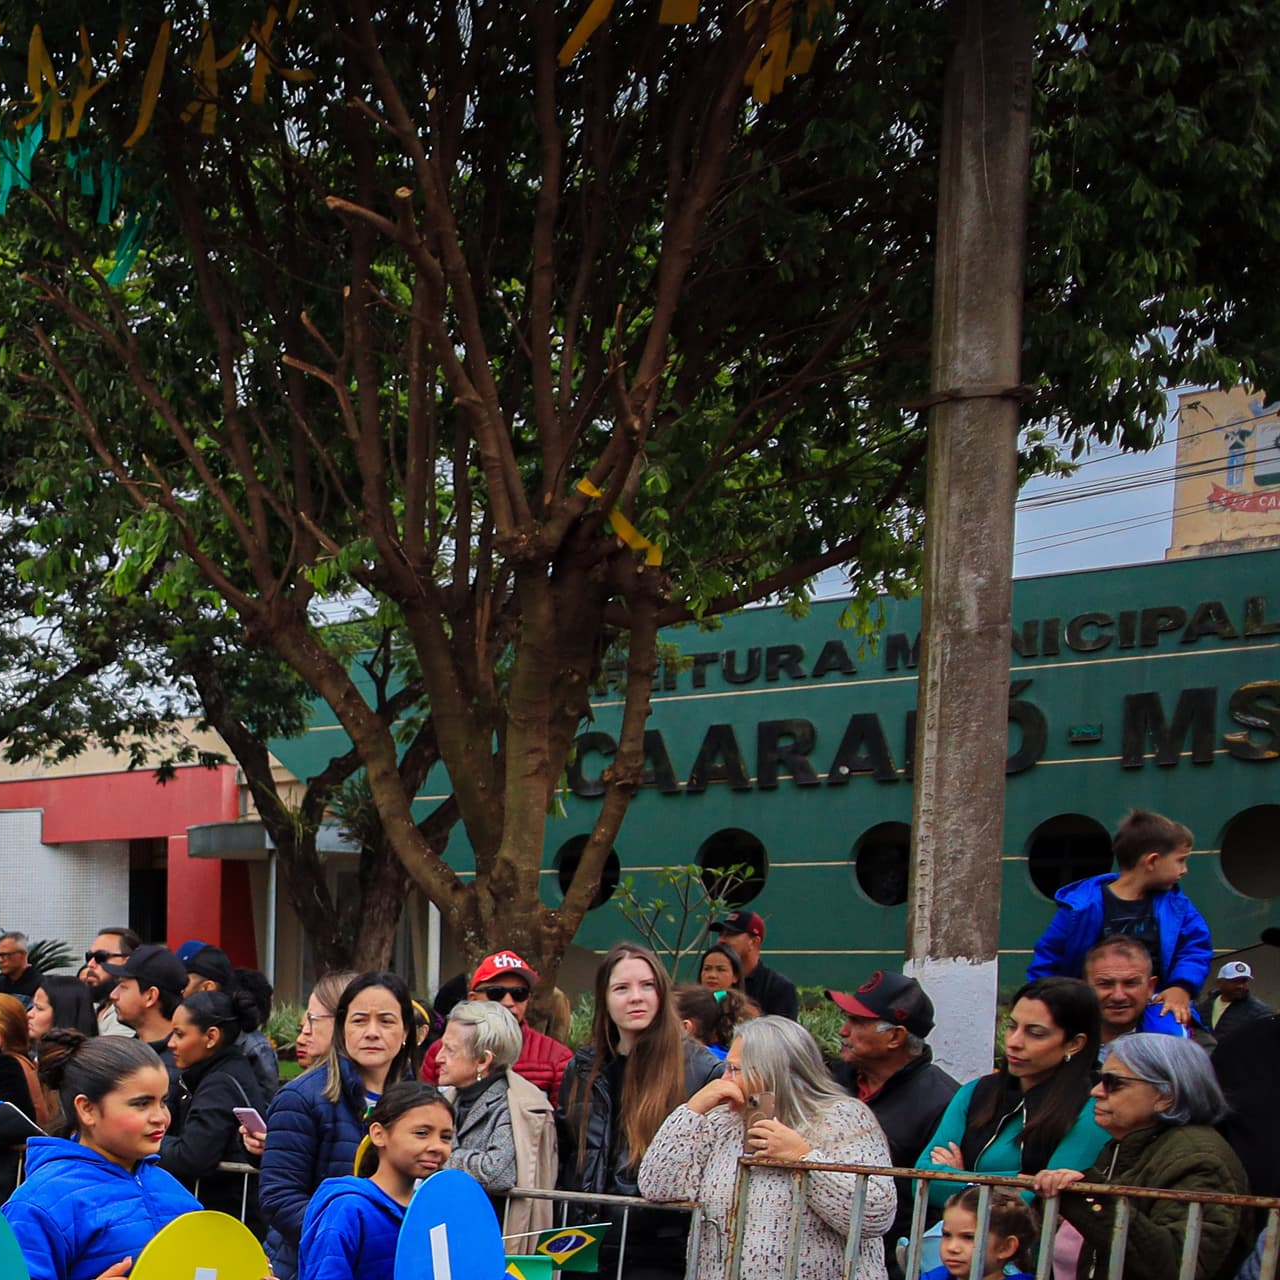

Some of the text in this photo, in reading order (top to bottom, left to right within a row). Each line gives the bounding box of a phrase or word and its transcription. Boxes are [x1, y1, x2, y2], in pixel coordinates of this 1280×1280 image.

[885, 596, 1280, 671] MNICIPAL
[566, 677, 1048, 797] CAARAÓ
[493, 954, 522, 968] thx
